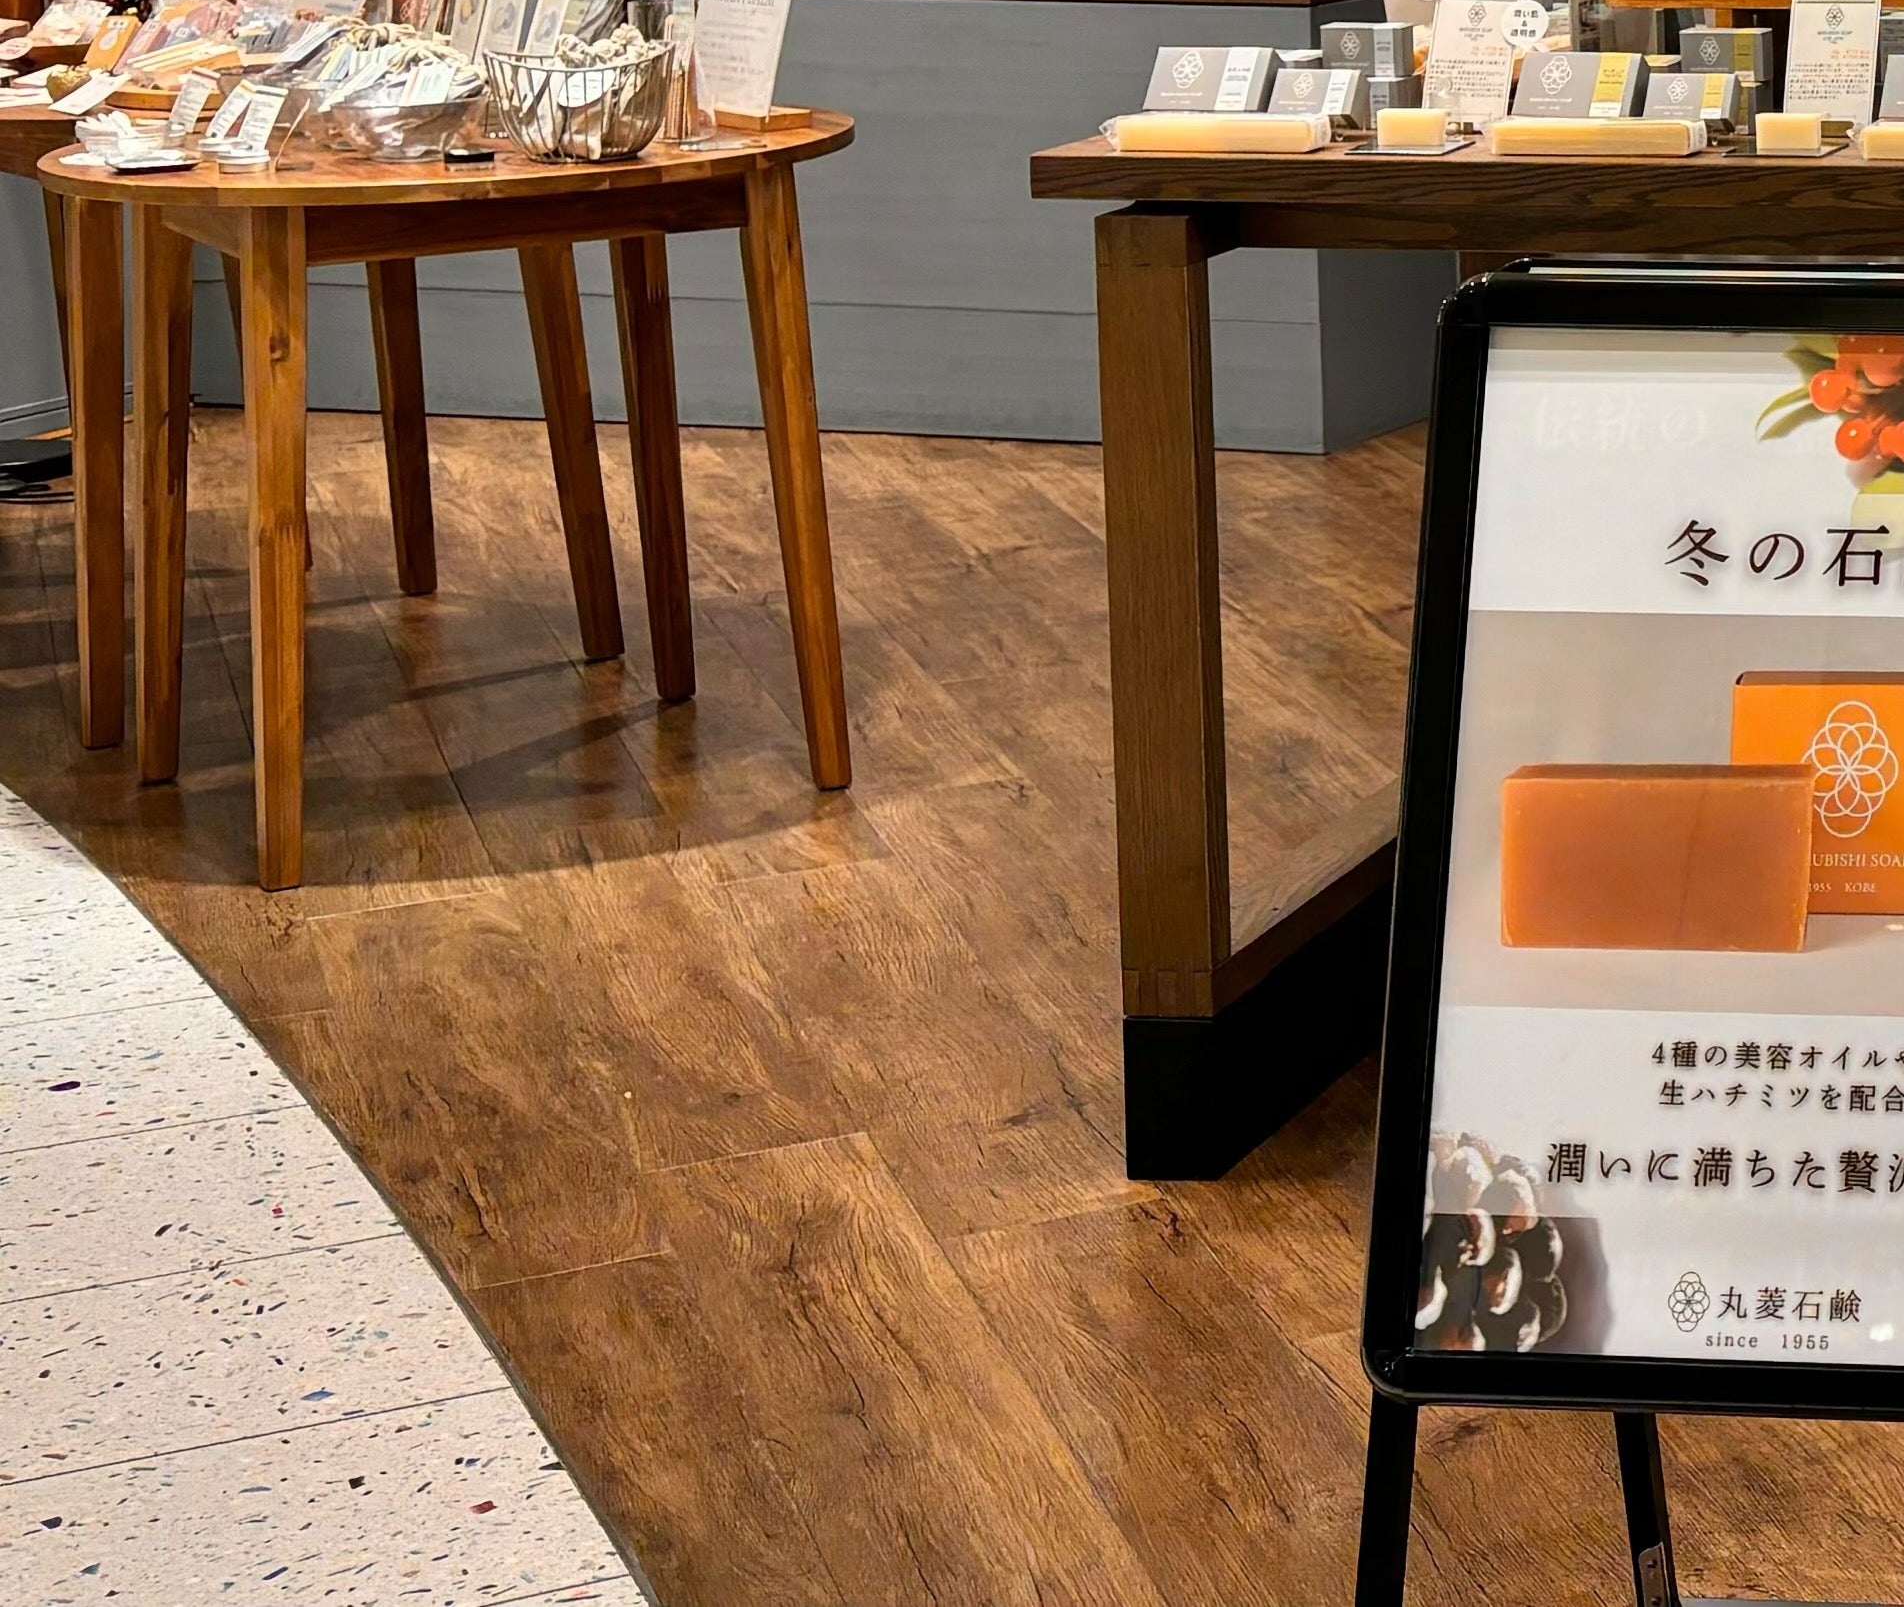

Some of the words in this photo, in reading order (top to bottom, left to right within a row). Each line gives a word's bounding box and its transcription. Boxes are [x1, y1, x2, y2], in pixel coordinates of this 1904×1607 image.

[1844, 882, 1876, 893] KOBE
[1717, 1286, 1863, 1324] 丸菱石鹸
[1705, 1333, 1758, 1348] since
[1781, 1333, 1830, 1351] 1955
